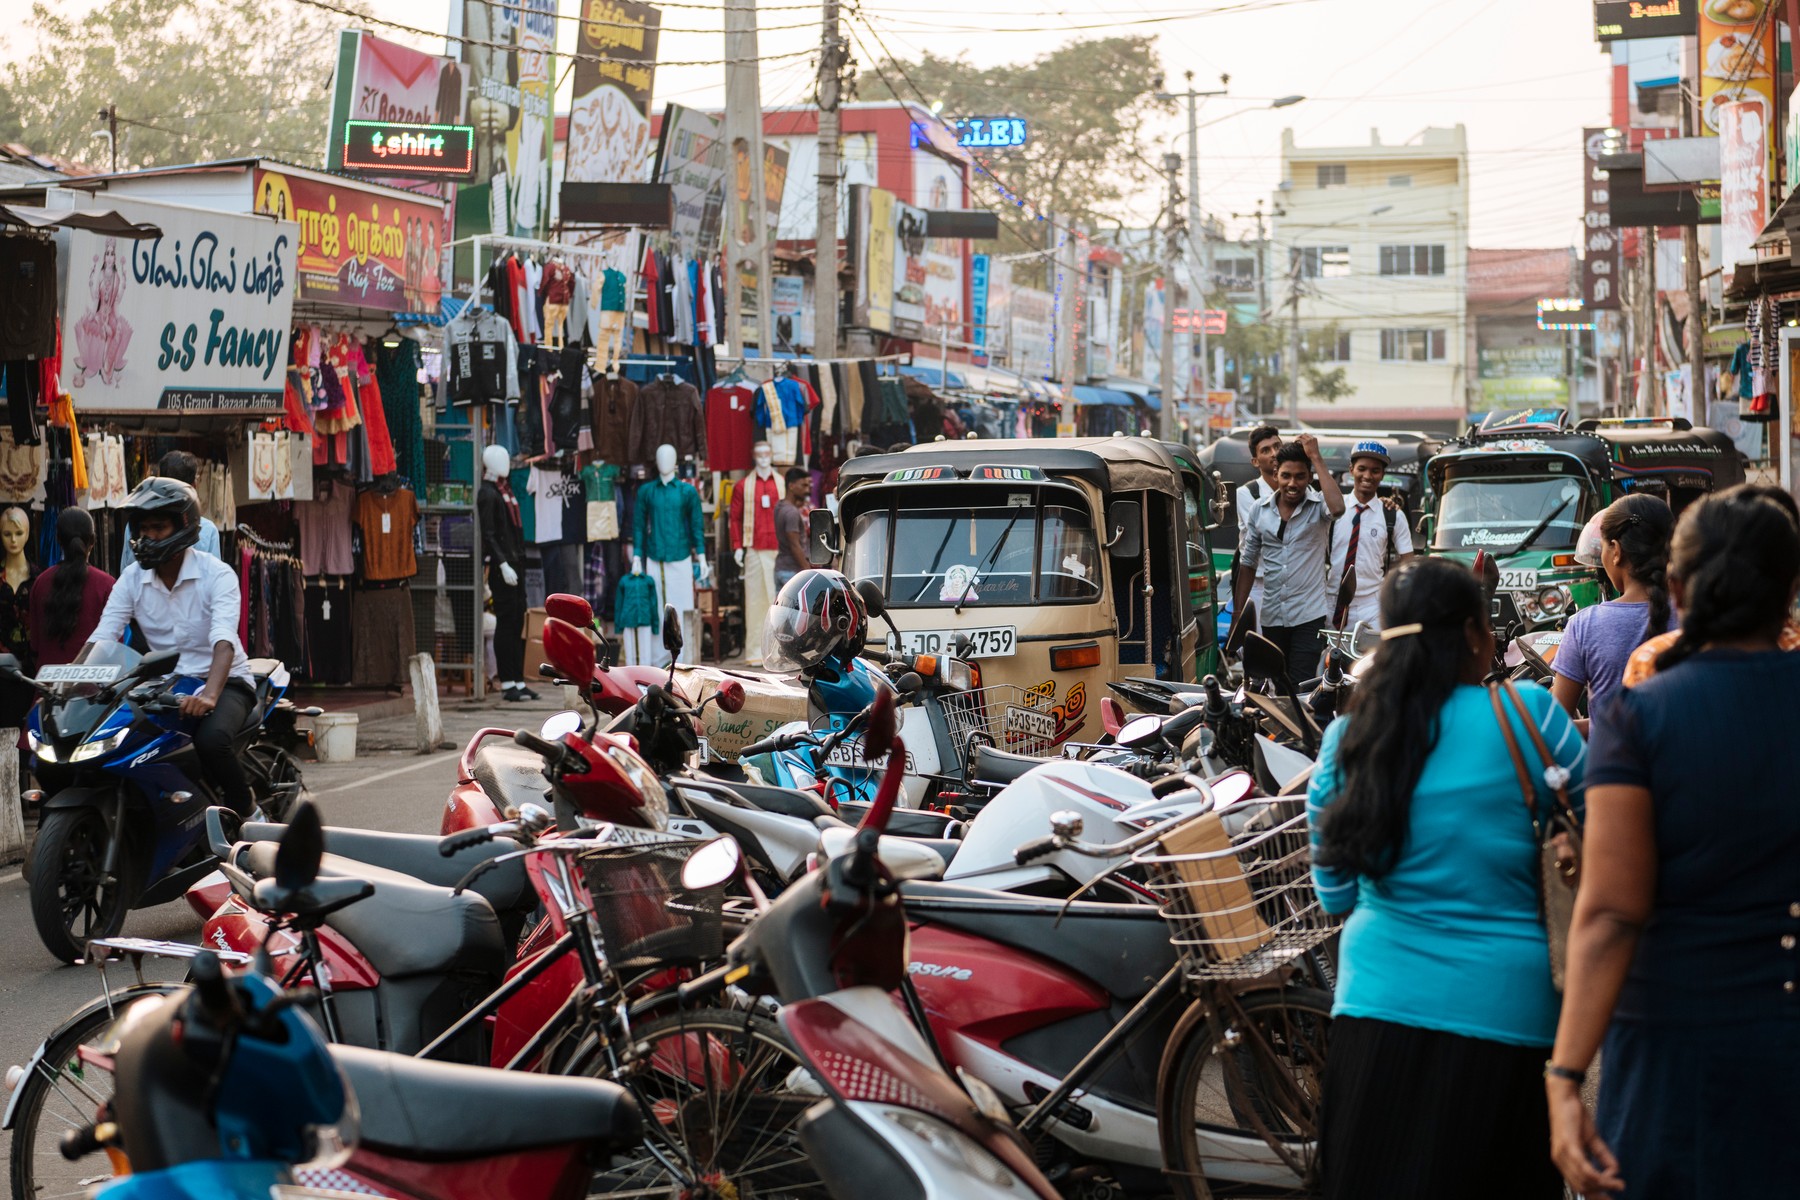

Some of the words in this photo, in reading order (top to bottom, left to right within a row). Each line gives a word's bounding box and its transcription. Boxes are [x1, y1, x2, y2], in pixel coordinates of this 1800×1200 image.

[371, 131, 445, 158] t,shirt
[346, 202, 404, 266] ரெக்ஸ்
[347, 258, 370, 298] Raj
[373, 263, 396, 292] Tex
[204, 308, 283, 381] Fancy
[184, 394, 214, 409] Grand
